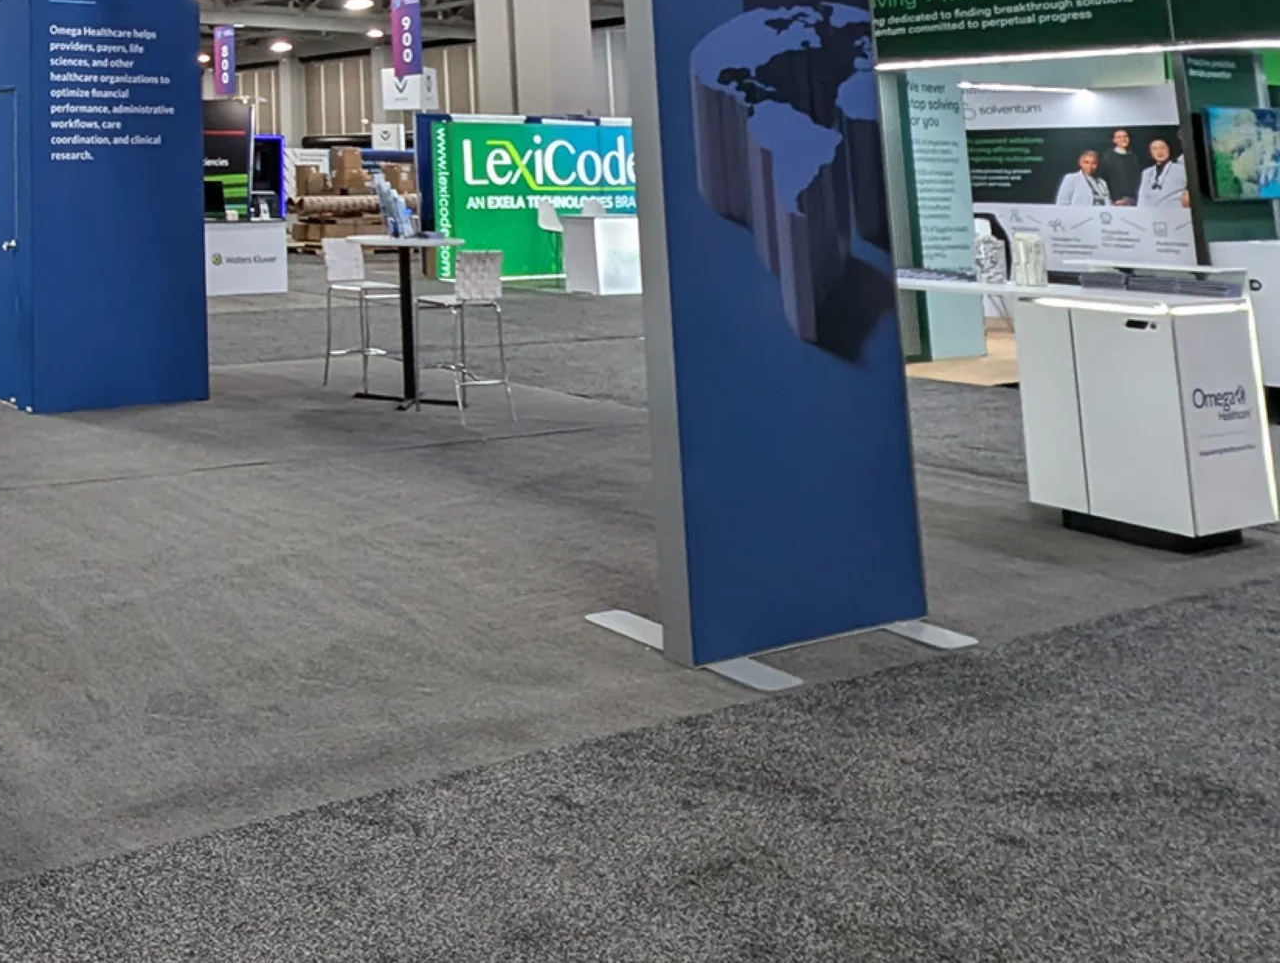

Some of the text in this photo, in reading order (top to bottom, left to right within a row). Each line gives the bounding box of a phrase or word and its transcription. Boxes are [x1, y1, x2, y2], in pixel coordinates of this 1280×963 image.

[940, 10, 951, 19] to
[954, 6, 992, 19] finding
[967, 20, 979, 29] to
[981, 12, 1036, 29] perpetual
[1038, 10, 1093, 24] progress
[49, 24, 157, 40] Omega Healthcare helps
[401, 15, 413, 64] 900
[50, 41, 144, 54] providers, payers, life
[50, 56, 134, 68] sciences, and other
[221, 44, 229, 84] 800
[50, 72, 170, 84] healthcare organizations to
[50, 88, 129, 99] optimize financial
[50, 103, 174, 115] performance, administrative
[50, 119, 121, 130] workflows, care
[51, 135, 161, 146] coordination, and clinical
[51, 150, 93, 161] research.
[467, 196, 485, 209] AN
[487, 195, 524, 209] EXELA
[1192, 388, 1235, 411] Omega
